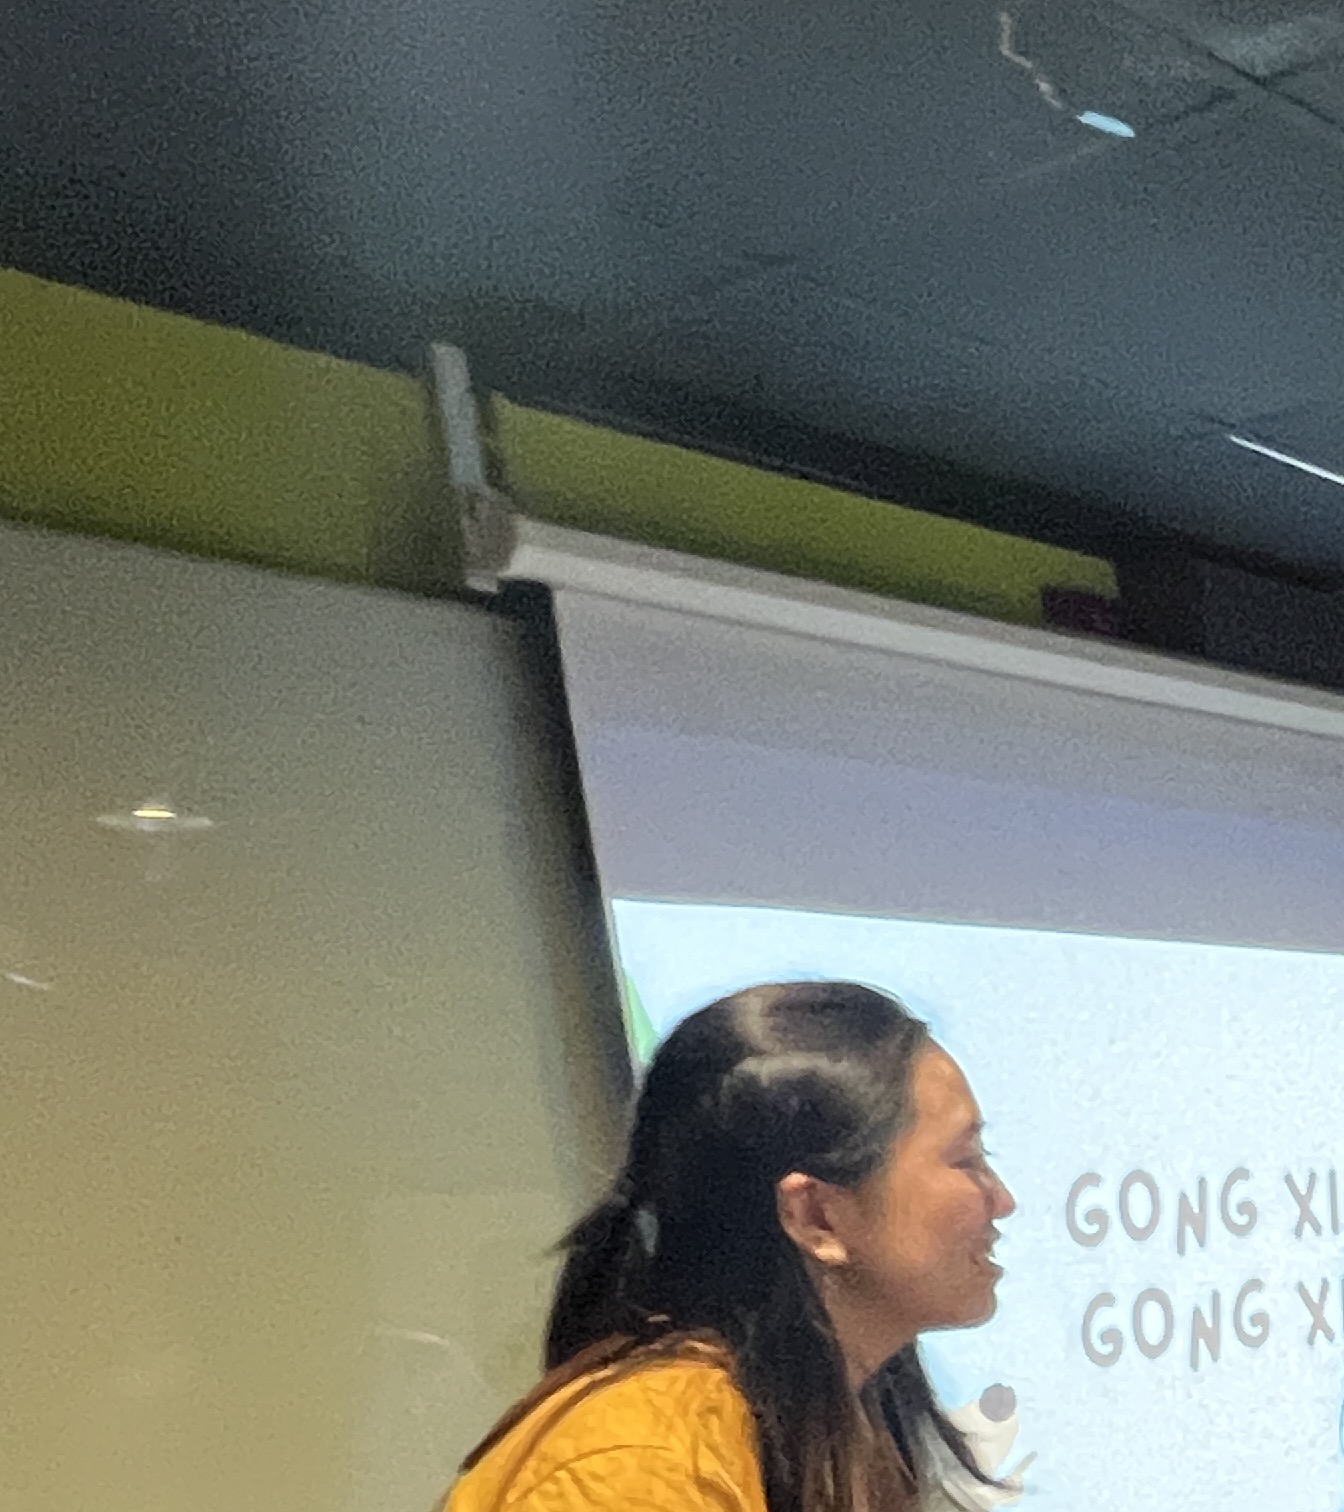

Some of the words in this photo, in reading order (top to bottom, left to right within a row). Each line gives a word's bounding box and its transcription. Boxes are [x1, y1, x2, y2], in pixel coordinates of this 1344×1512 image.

[1066, 1167, 1258, 1256] GONG
[1284, 1168, 1340, 1239] XI
[1082, 1278, 1270, 1371] GONG
